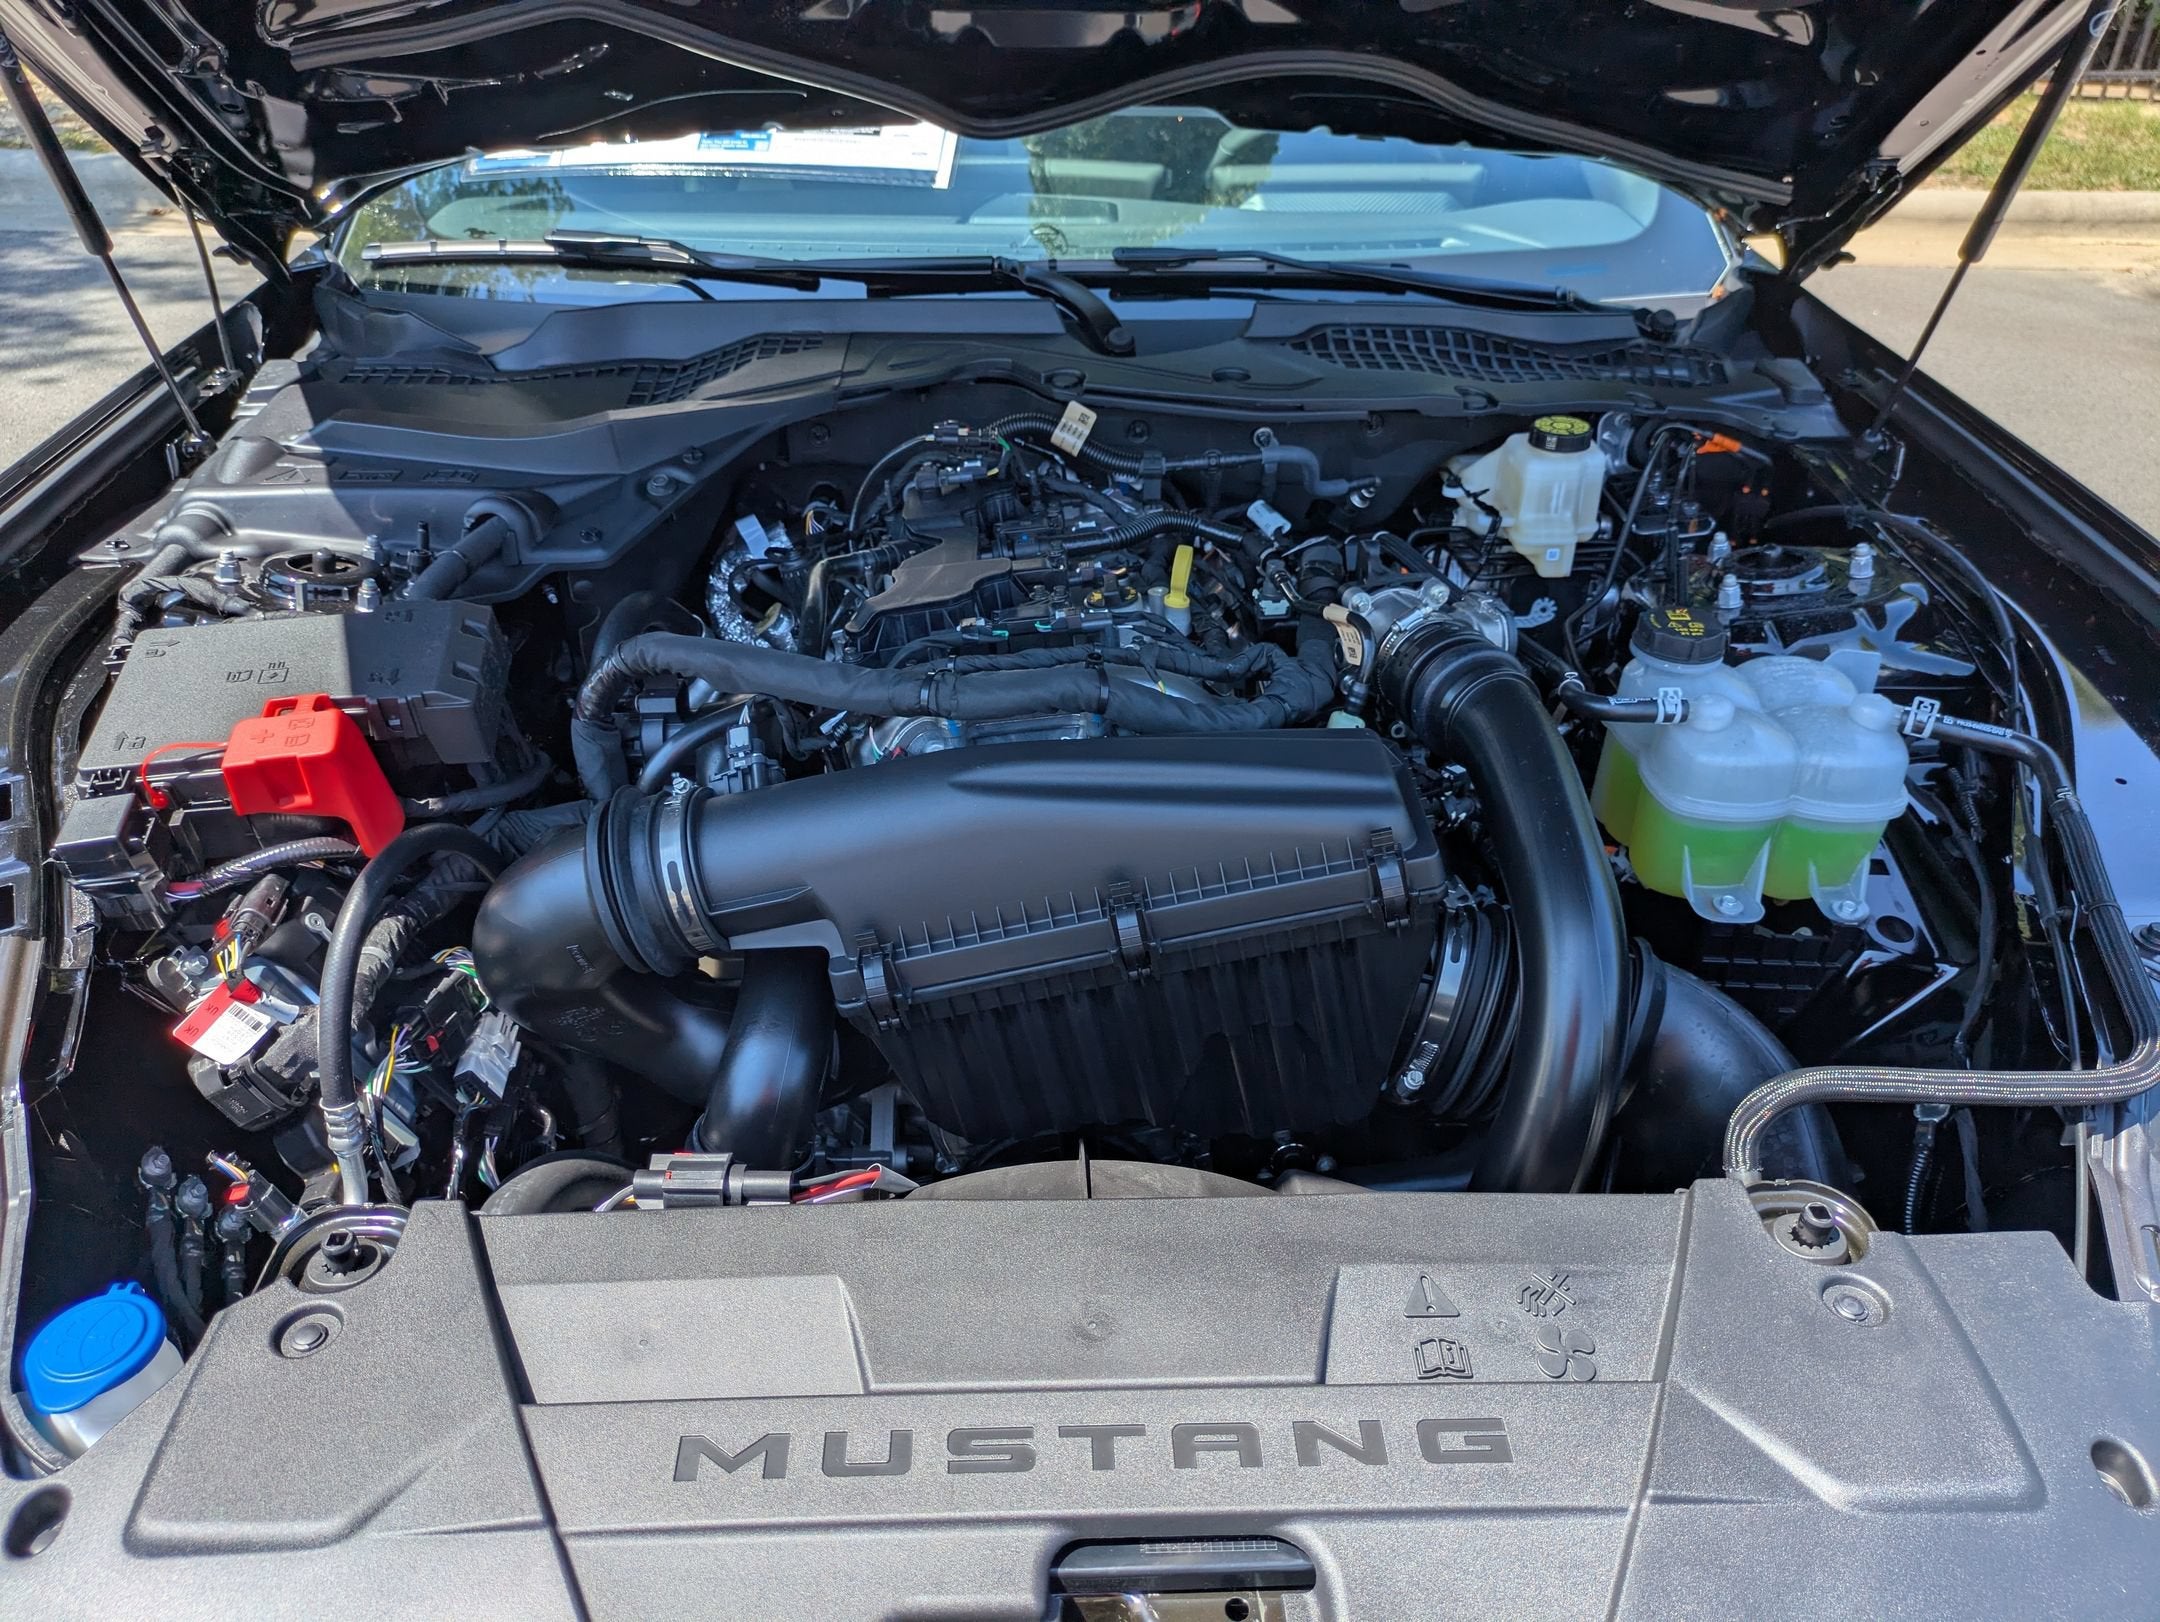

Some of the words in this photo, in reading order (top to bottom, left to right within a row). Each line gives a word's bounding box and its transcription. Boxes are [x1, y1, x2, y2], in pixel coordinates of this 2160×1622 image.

[205, 1002, 219, 1016] UK
[183, 1023, 200, 1037] UK
[673, 1416, 1514, 1482] MUSTANG
